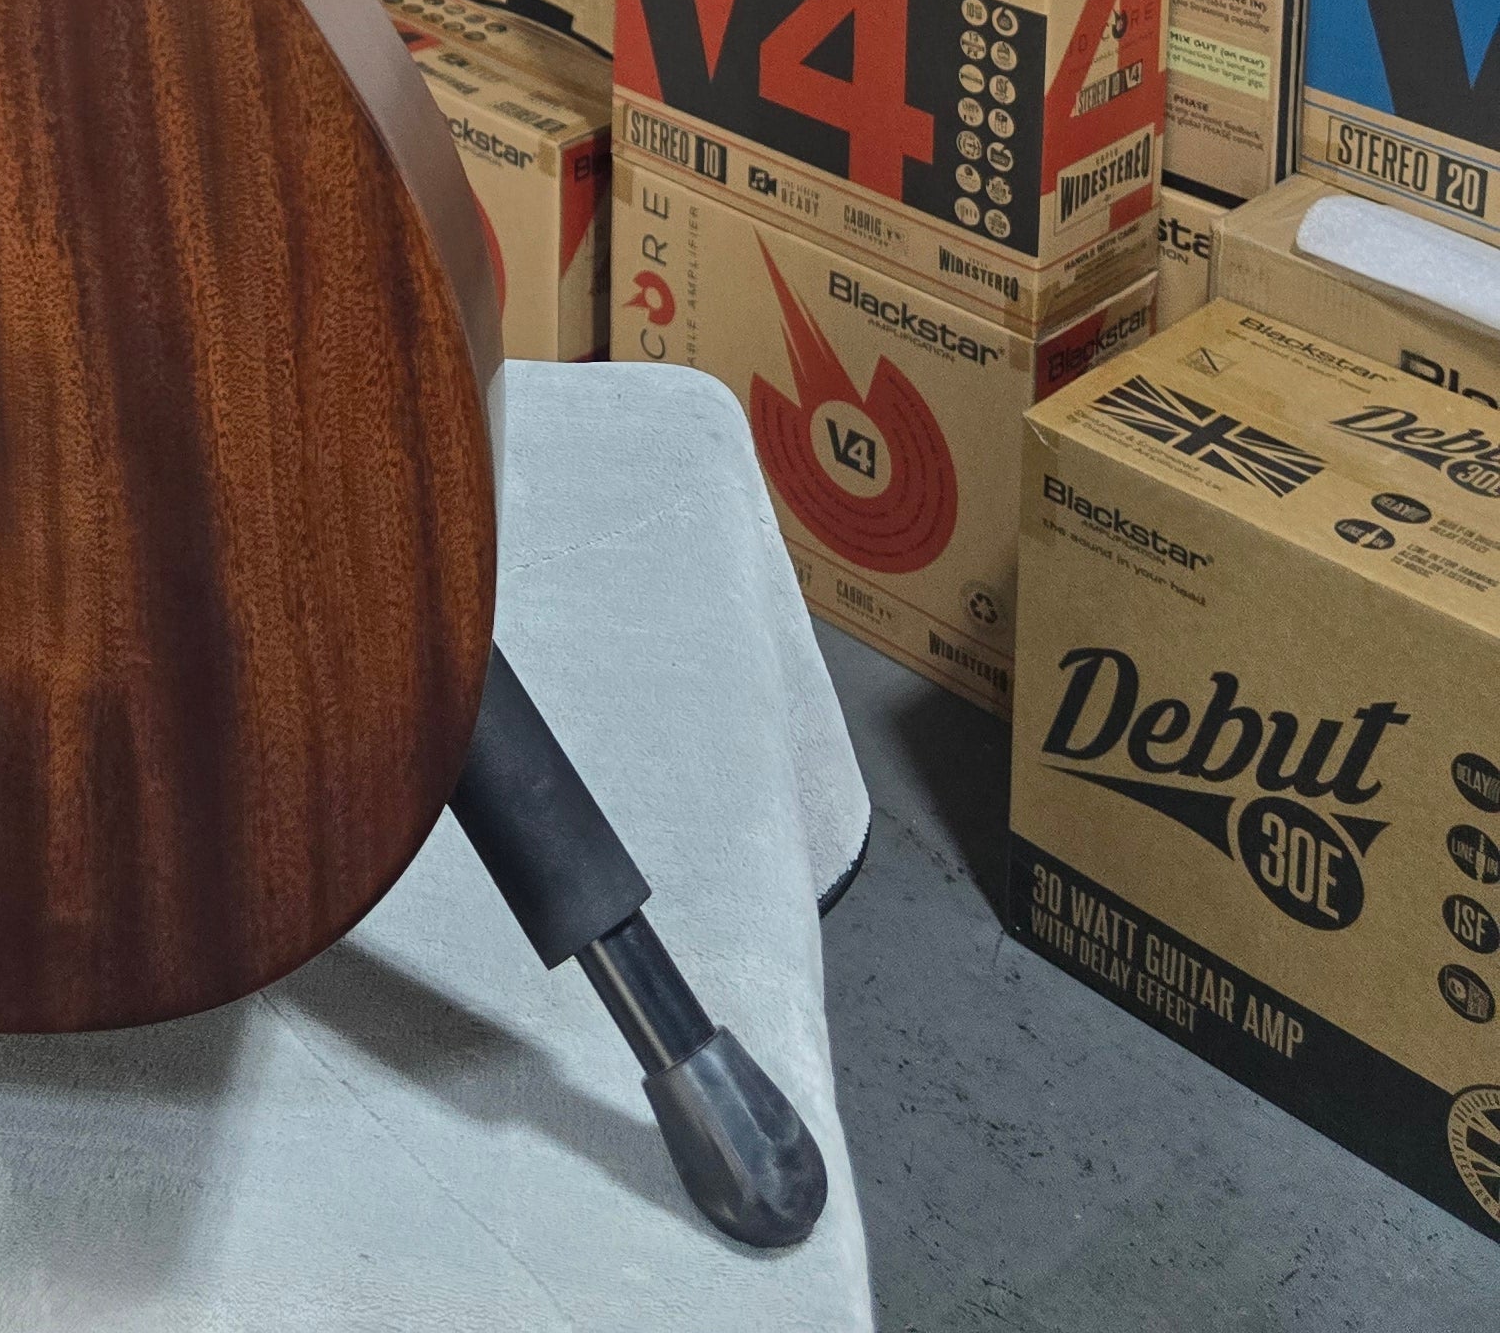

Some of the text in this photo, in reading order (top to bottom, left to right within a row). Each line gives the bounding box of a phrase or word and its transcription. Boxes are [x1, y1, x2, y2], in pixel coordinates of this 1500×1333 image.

[1170, 31, 1191, 45] MIX
[1194, 39, 1217, 54] OUT
[1174, 93, 1210, 112] PHASE
[449, 117, 534, 170] ckstar
[631, 110, 719, 178] STEREO 10
[1061, 133, 1150, 224] WIDESTEREO
[1338, 123, 1480, 211] STEREO 20
[843, 204, 881, 236] CABRIG
[687, 205, 699, 310] AMPLIFIER
[938, 245, 1019, 302] WIDESTEREO
[829, 270, 999, 366] Blackstar
[867, 318, 955, 363] AMPLIFICATION
[1047, 306, 1151, 382] Blackstar
[1239, 316, 1389, 382] Blackstar
[826, 417, 876, 479] V4
[1044, 473, 1207, 571] Blackstar
[1081, 519, 1166, 566] AMPLIFICATION
[1042, 518, 1206, 606] the sound in your head
[1041, 647, 1411, 804] Debut
[1260, 812, 1342, 921] 30E
[1454, 900, 1489, 946] ISF
[1031, 905, 1197, 1034] WITH DELAY EFFECT
[1032, 863, 1304, 1059] 30 WATT GUITAR AMP
